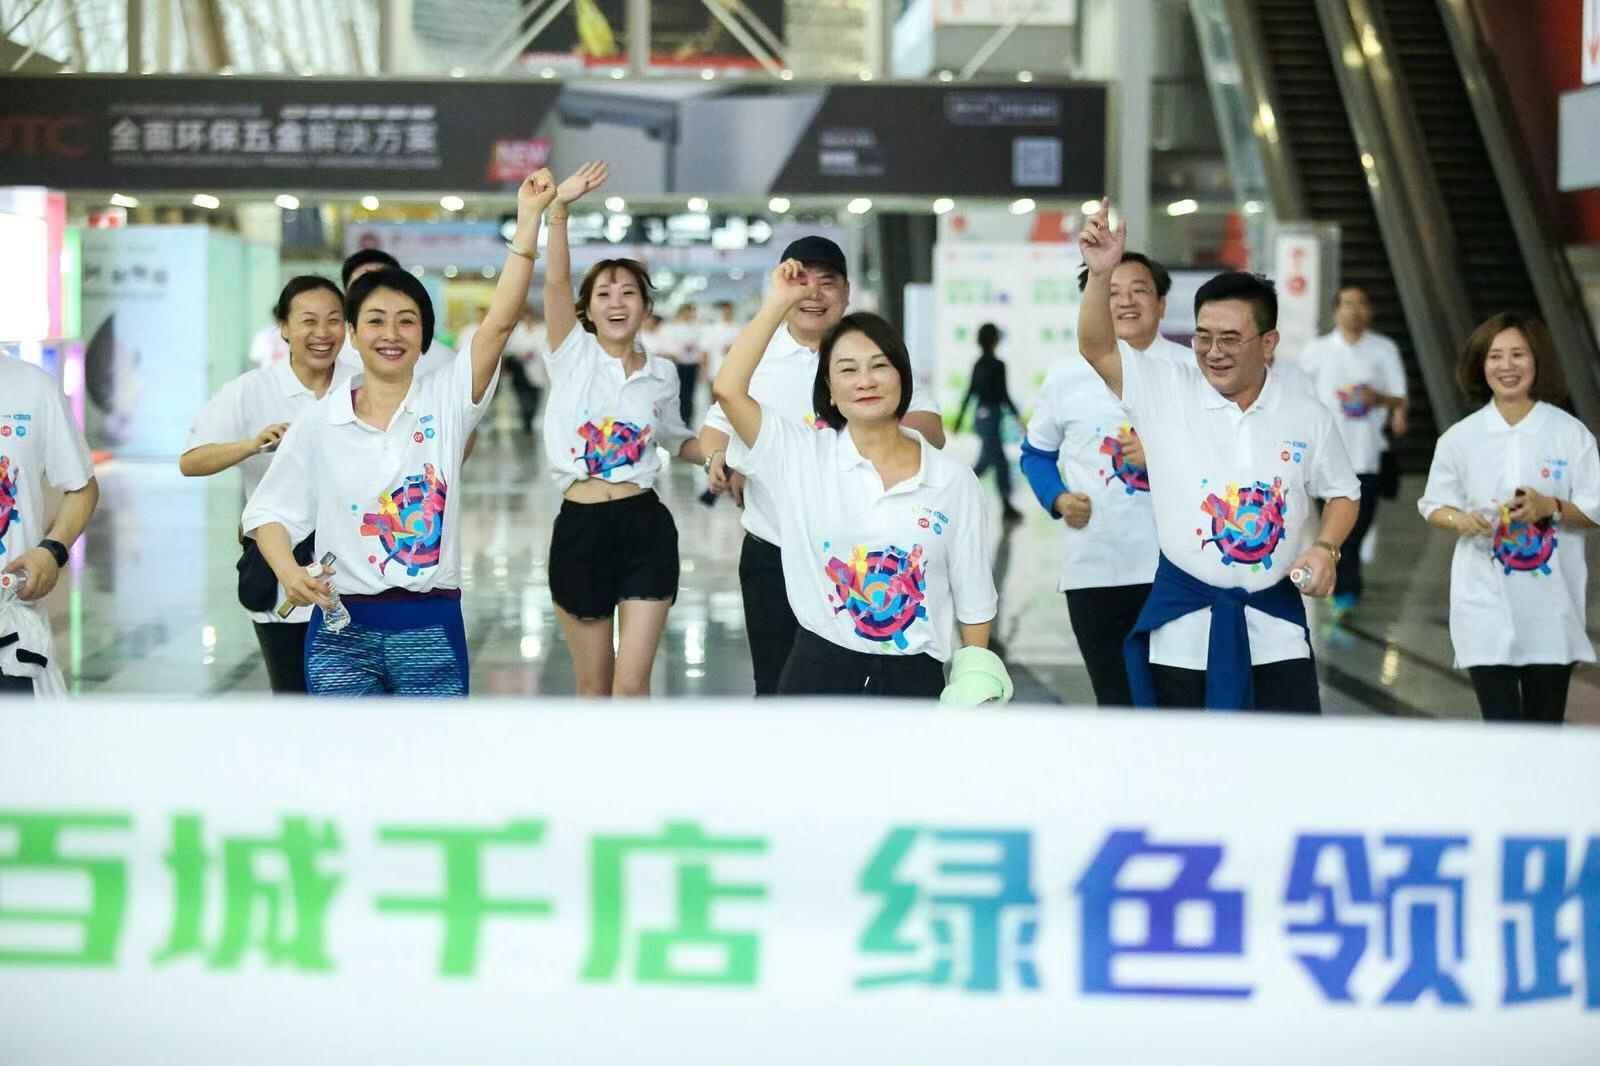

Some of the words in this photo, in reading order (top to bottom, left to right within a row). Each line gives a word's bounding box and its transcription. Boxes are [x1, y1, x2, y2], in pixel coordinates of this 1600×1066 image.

[109, 118, 438, 152] 全面环保五金解决方案
[495, 141, 549, 167] NEW
[0, 812, 768, 988] 百城千店
